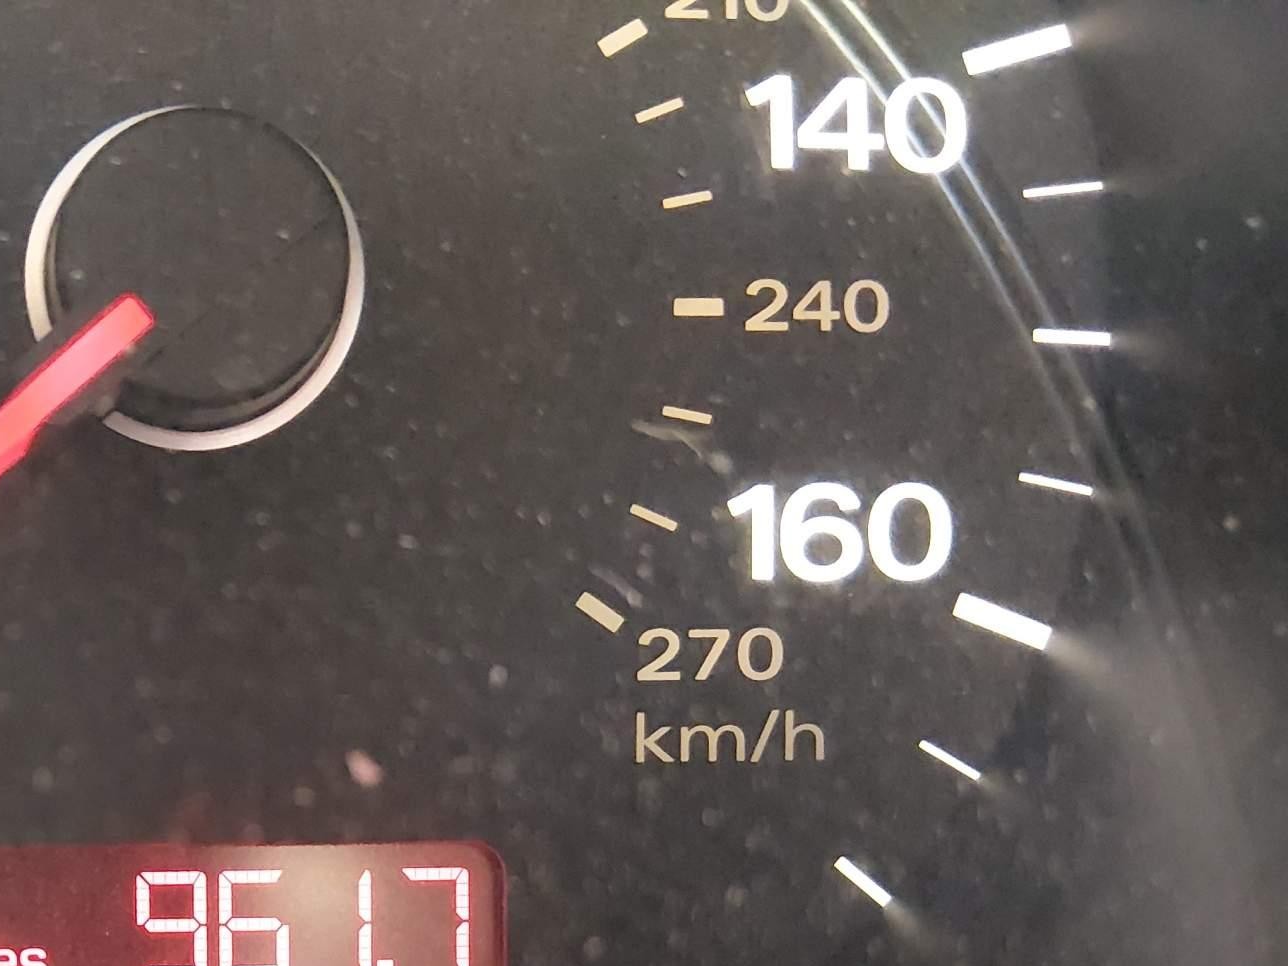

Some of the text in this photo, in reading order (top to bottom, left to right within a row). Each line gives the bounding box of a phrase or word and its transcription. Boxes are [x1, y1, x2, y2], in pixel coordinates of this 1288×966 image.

[744, 74, 967, 173] 140
[744, 278, 890, 333] 240
[727, 482, 953, 583] 160
[637, 627, 784, 681] 270
[635, 709, 825, 763] km/h
